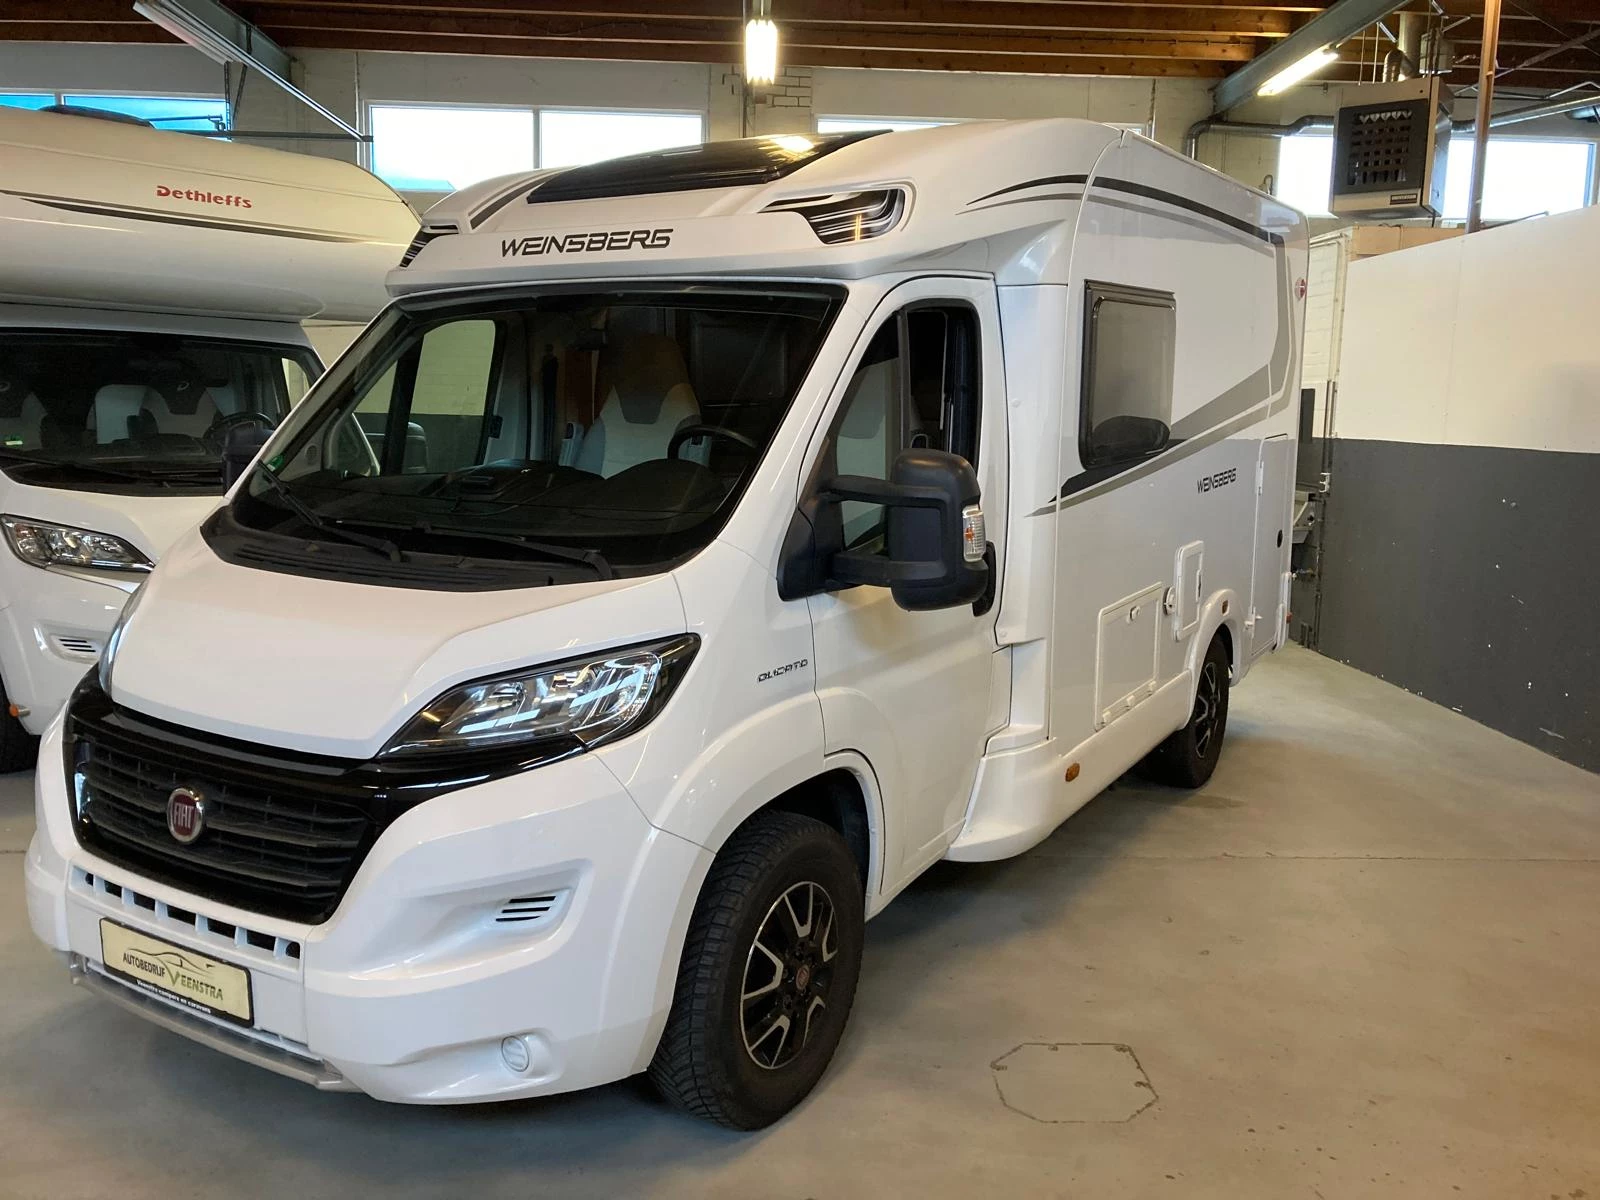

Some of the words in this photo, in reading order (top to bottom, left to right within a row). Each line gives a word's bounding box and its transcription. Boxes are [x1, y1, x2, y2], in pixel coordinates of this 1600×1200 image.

[156, 185, 252, 209] Dethleffs
[501, 228, 674, 258] WEINSBERG
[1196, 467, 1237, 494] WEINSBERG
[173, 802, 195, 829] FIAT
[123, 952, 166, 977] AUTOBEDRIJF
